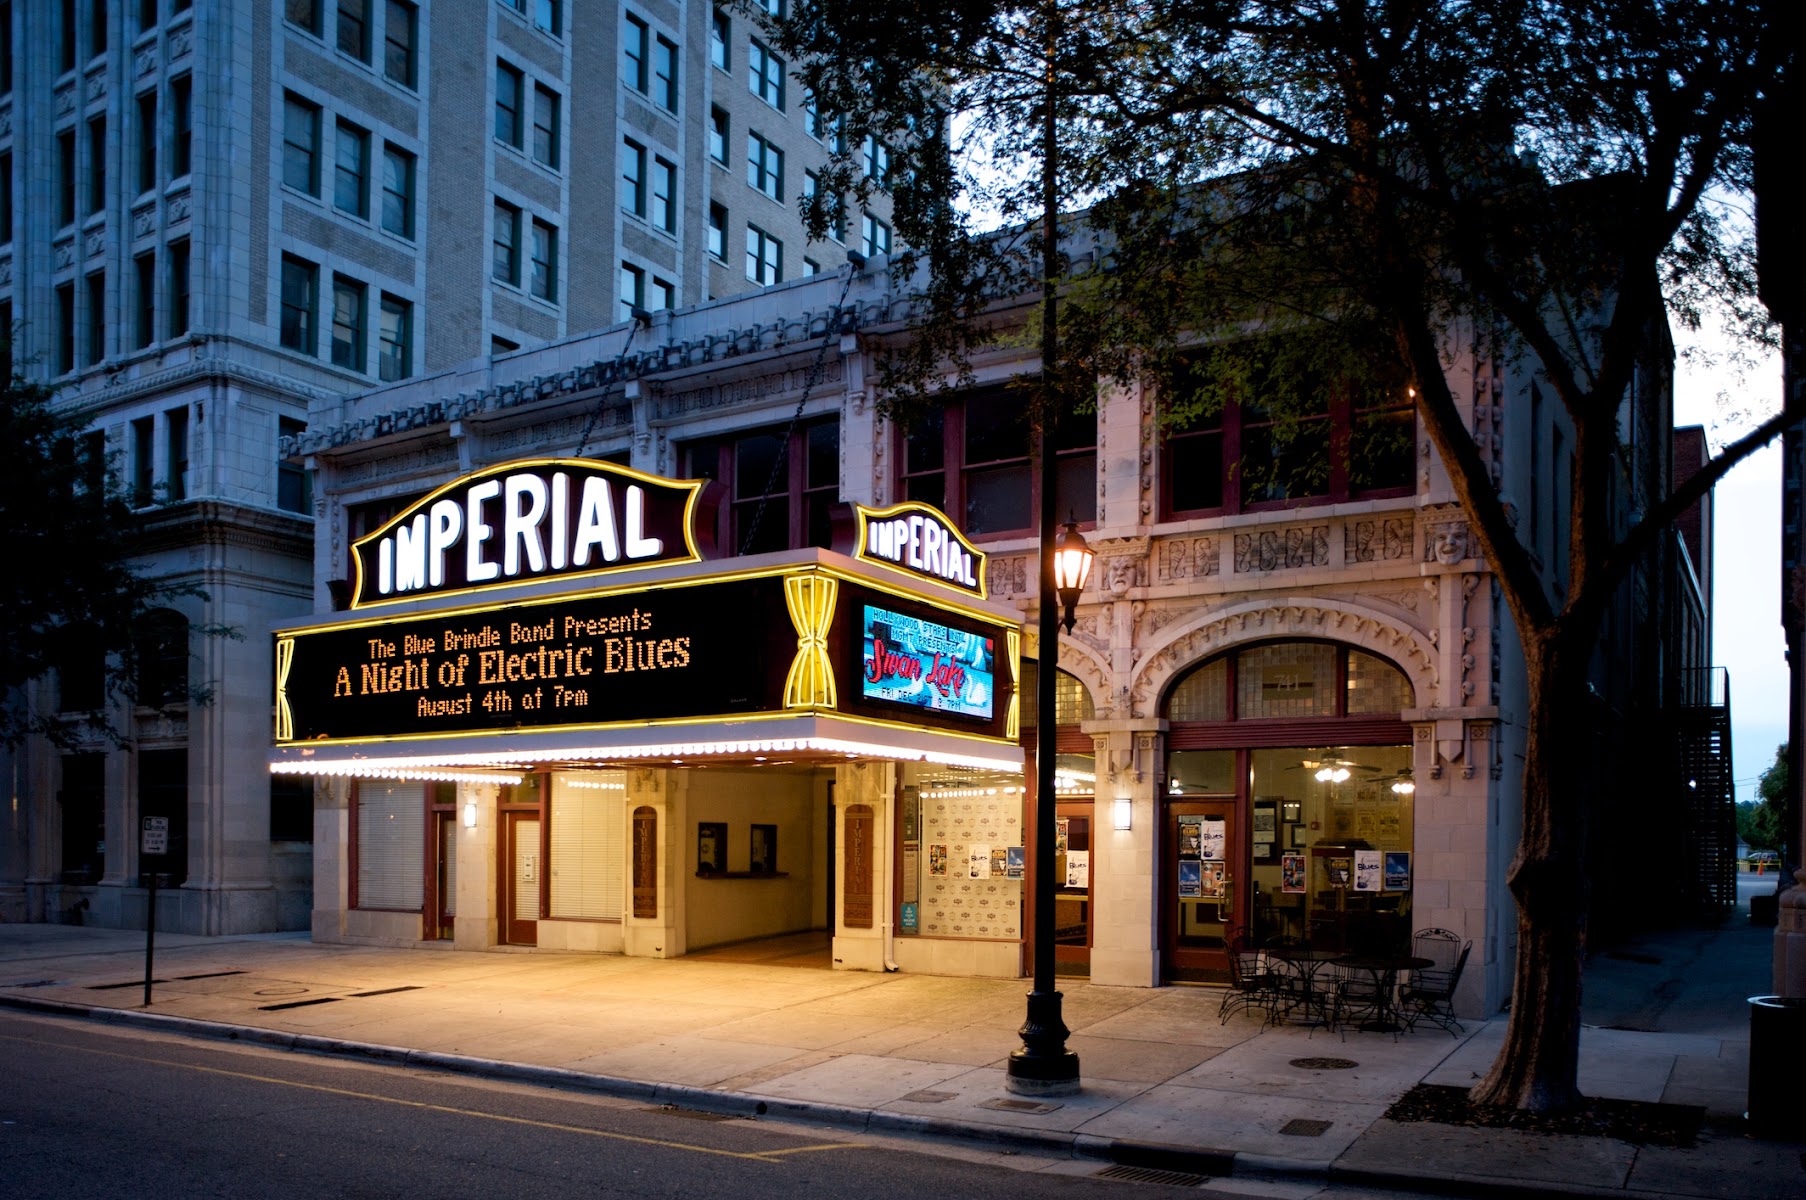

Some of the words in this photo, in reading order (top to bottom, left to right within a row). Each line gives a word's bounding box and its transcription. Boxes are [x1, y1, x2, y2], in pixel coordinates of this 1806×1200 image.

[378, 472, 663, 594] IMPERIAL
[869, 515, 976, 587] IMPERIAL
[368, 639, 396, 660] The
[404, 634, 435, 654] Blue
[444, 625, 500, 651] Brindle
[511, 617, 554, 642] Band
[565, 608, 652, 639] Presents
[873, 609, 919, 630] HOLLYWOOD
[922, 621, 947, 638] STARS
[918, 635, 957, 653] PRESENTS
[334, 666, 353, 697] A
[361, 658, 429, 695] Night
[439, 654, 469, 687] of
[479, 643, 593, 685] Electric
[604, 636, 690, 675] Blues
[865, 639, 921, 684] Swan
[926, 652, 966, 698] Lake
[1274, 673, 1300, 691] 741
[418, 692, 472, 717] August
[482, 689, 512, 712] 4th
[522, 687, 543, 710] at
[554, 684, 589, 707] 7pm
[882, 687, 894, 698] FRI
[898, 690, 912, 702] DEC
[640, 820, 649, 887] IMPERIAL
[1203, 833, 1224, 841] Blues
[853, 819, 863, 894] IMPERIAL
[970, 854, 988, 862] Blues
[1357, 863, 1380, 871] Blues
